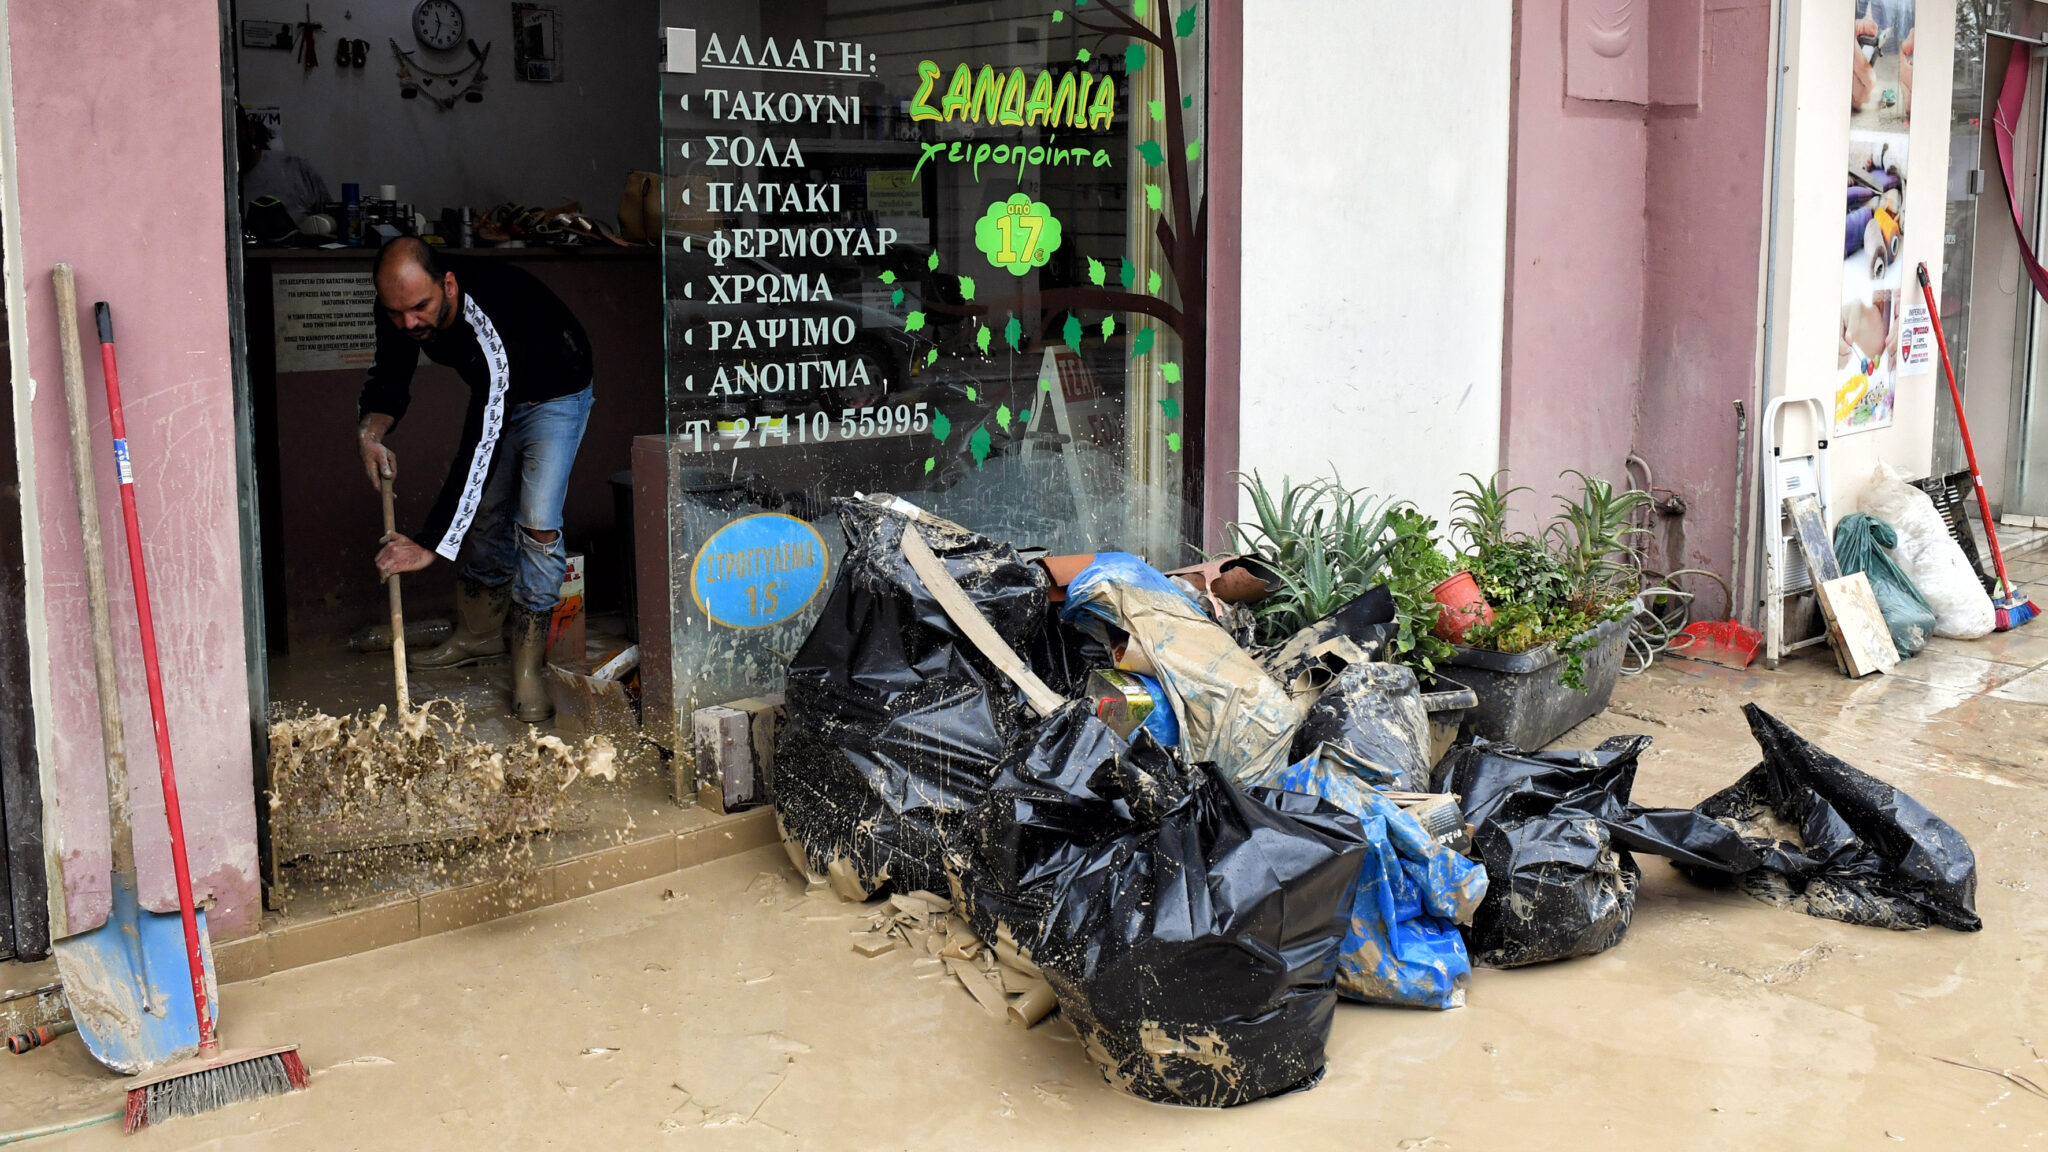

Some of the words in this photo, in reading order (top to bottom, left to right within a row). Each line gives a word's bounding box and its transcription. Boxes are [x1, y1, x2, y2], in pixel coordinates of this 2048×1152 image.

[702, 33, 876, 77] ΑΛΛΑΓΗ:
[705, 89, 861, 125] ΤΑΚΟΥΝΙ
[910, 60, 1115, 130] ΣΑΝΔΑΛΙΑ
[705, 136, 805, 168] ΣΟΛΑ
[706, 182, 841, 214] ΠΑΤΑΚΙ
[1007, 201, 1031, 215] από
[707, 273, 834, 305] ΧΡΩΜΑ
[708, 315, 856, 351] ΡΑΨΙΜΟ
[708, 358, 871, 396] ΑΝΟΙΓΜΑ
[733, 411, 830, 449] 27410
[840, 402, 928, 440] 55995
[705, 541, 814, 583] ΣΤΡΟΓΓΥΛΕΜΑ
